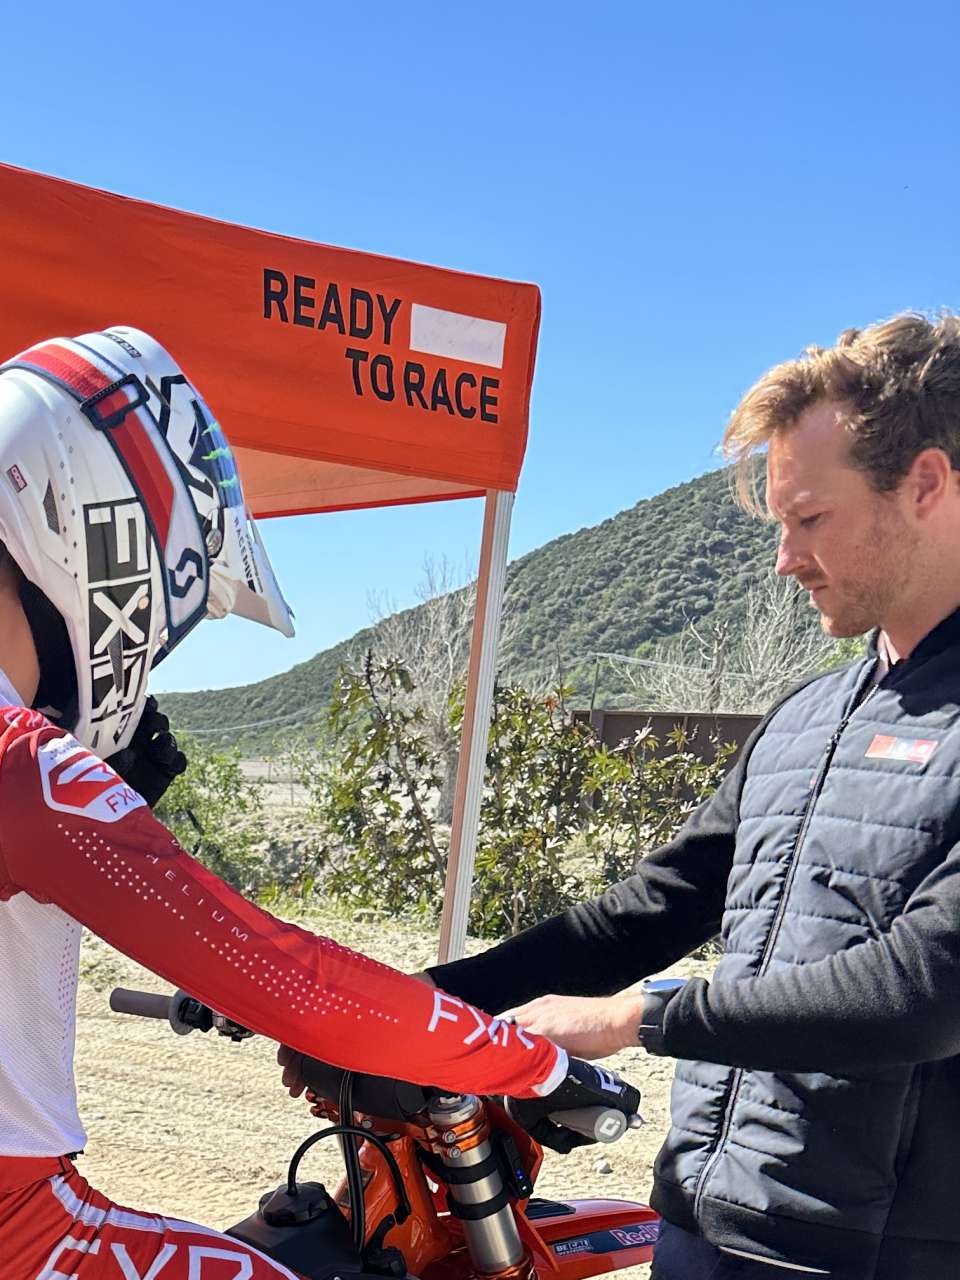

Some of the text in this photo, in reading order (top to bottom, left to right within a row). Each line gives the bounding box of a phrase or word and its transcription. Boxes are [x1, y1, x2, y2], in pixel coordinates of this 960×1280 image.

[263, 268, 402, 345] READY
[345, 347, 500, 424] TO RACE
